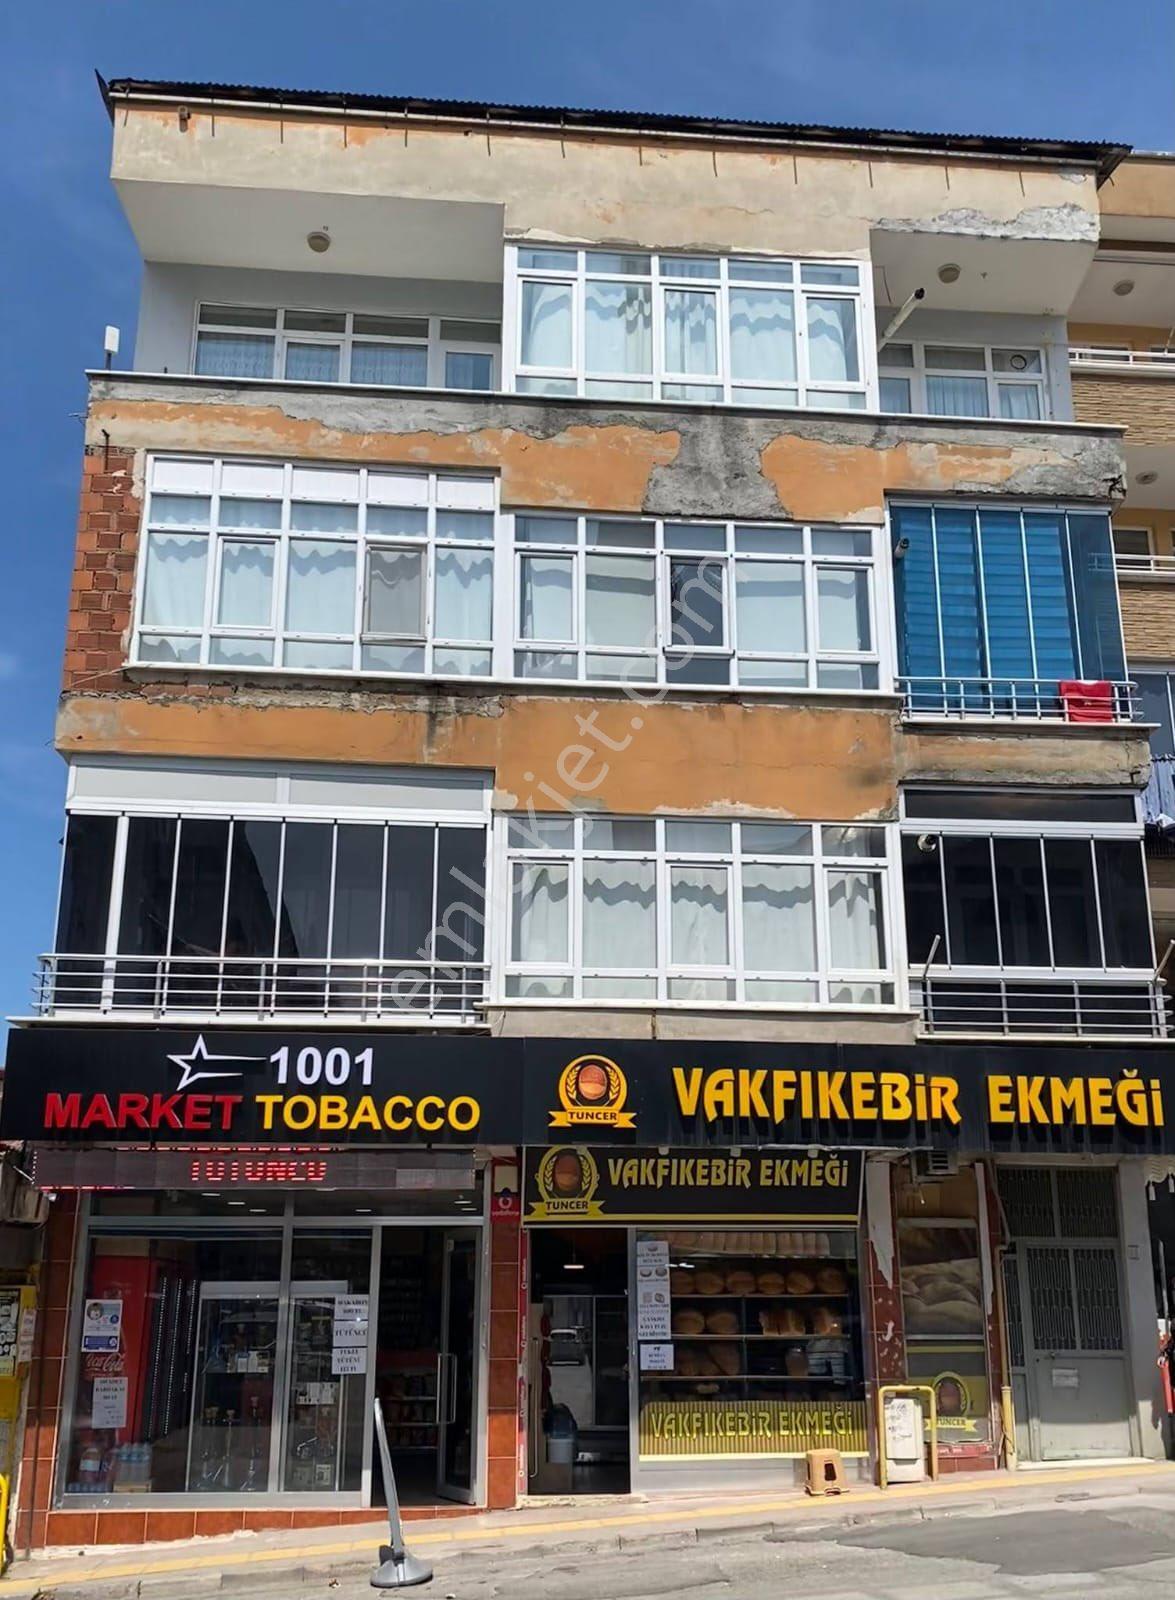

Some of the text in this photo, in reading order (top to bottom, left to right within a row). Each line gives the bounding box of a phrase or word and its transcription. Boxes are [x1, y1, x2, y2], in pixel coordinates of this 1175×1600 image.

[270, 1046, 374, 1086] 1001
[44, 1093, 481, 1131] MARKET TOBACCO
[568, 1111, 617, 1121] TUNCER
[546, 1201, 588, 1210] TUNCER
